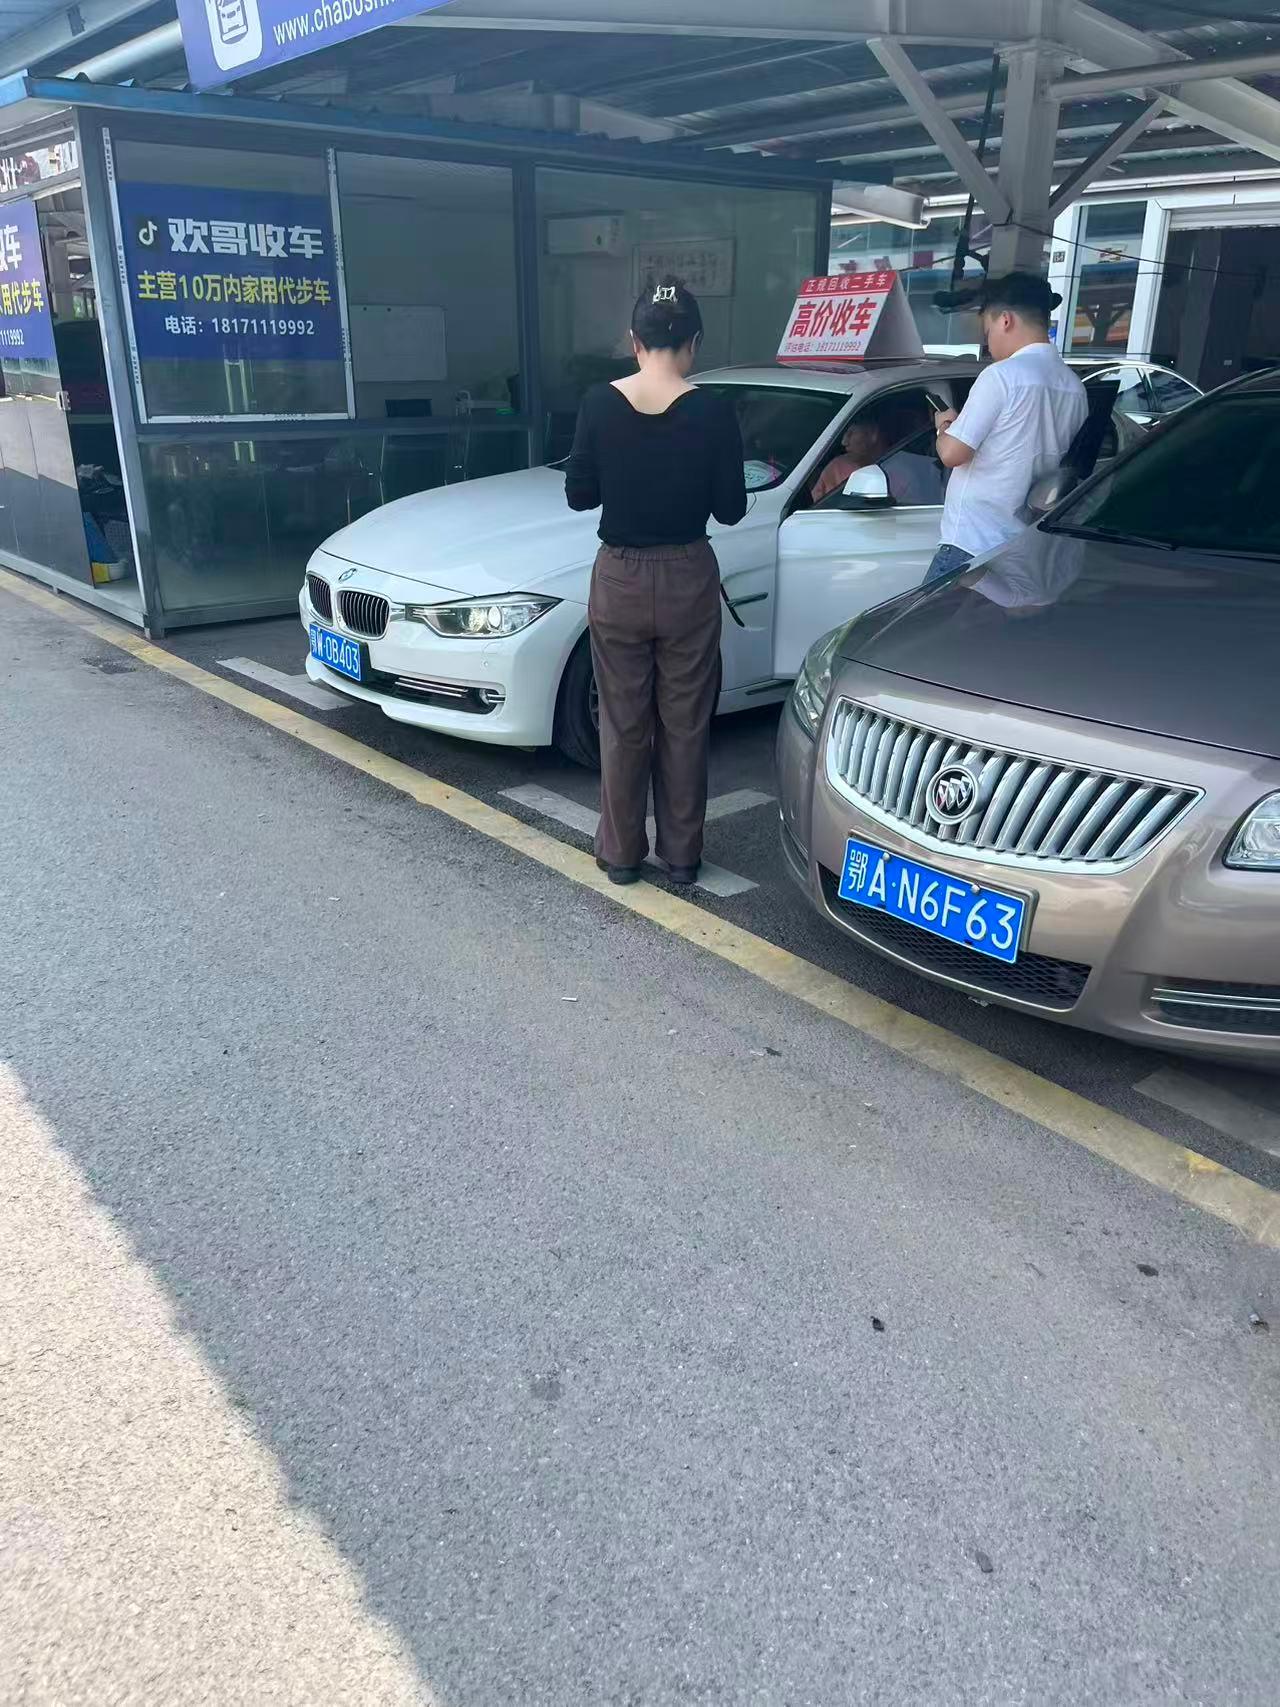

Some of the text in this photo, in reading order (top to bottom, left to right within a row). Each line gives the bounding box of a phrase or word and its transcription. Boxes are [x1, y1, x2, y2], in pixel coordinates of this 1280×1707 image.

[168, 218, 324, 259] 欢哥收车
[0, 278, 44, 314] 用代步车
[137, 271, 331, 306] 主营10万内家用代步车
[805, 273, 888, 293] 正规回收二手车
[789, 297, 877, 338] 高价收车
[848, 849, 1017, 950] 鄂A·N6F63
